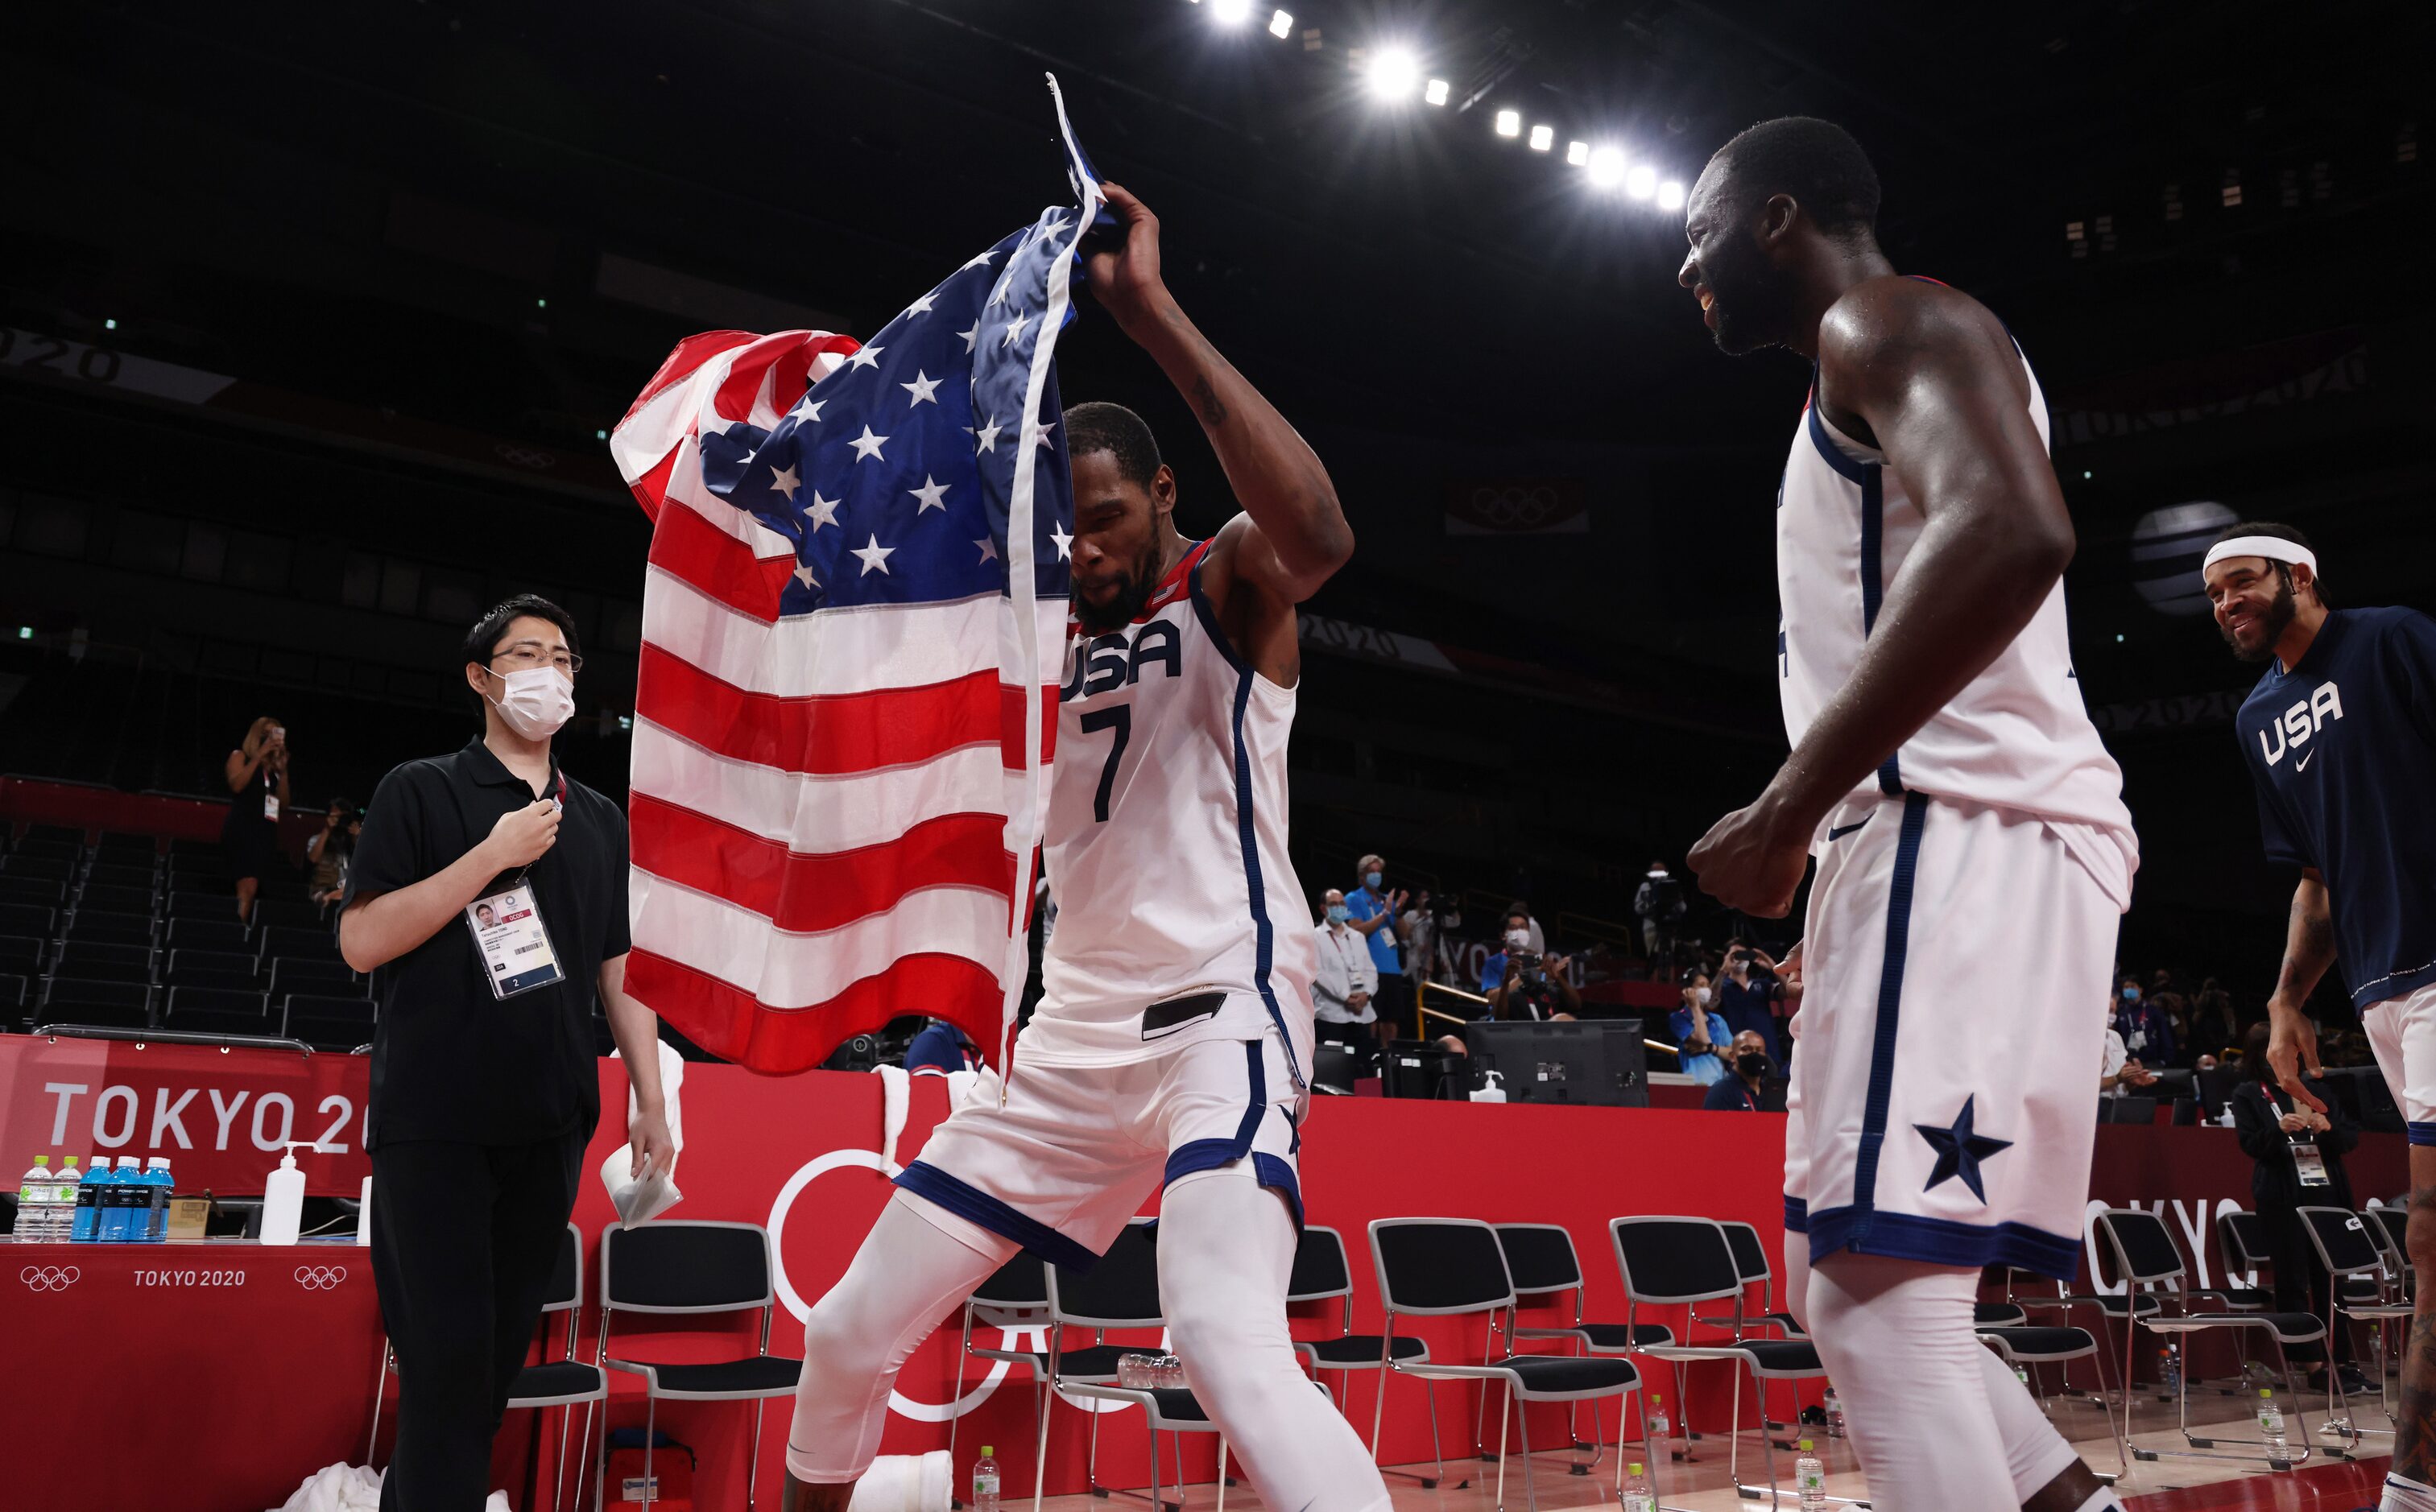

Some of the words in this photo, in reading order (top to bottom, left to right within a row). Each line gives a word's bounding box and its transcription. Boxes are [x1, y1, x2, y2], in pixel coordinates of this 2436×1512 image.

[1299, 613, 1401, 659] 2020
[2259, 680, 2344, 766] USA
[1080, 704, 1131, 822] 7
[508, 912, 524, 921] OCOG
[512, 978, 520, 987] 2
[44, 1082, 295, 1152] TOKYO
[317, 1094, 370, 1154] 2
[134, 1270, 196, 1286] TOKYO
[200, 1270, 246, 1286] 2020
